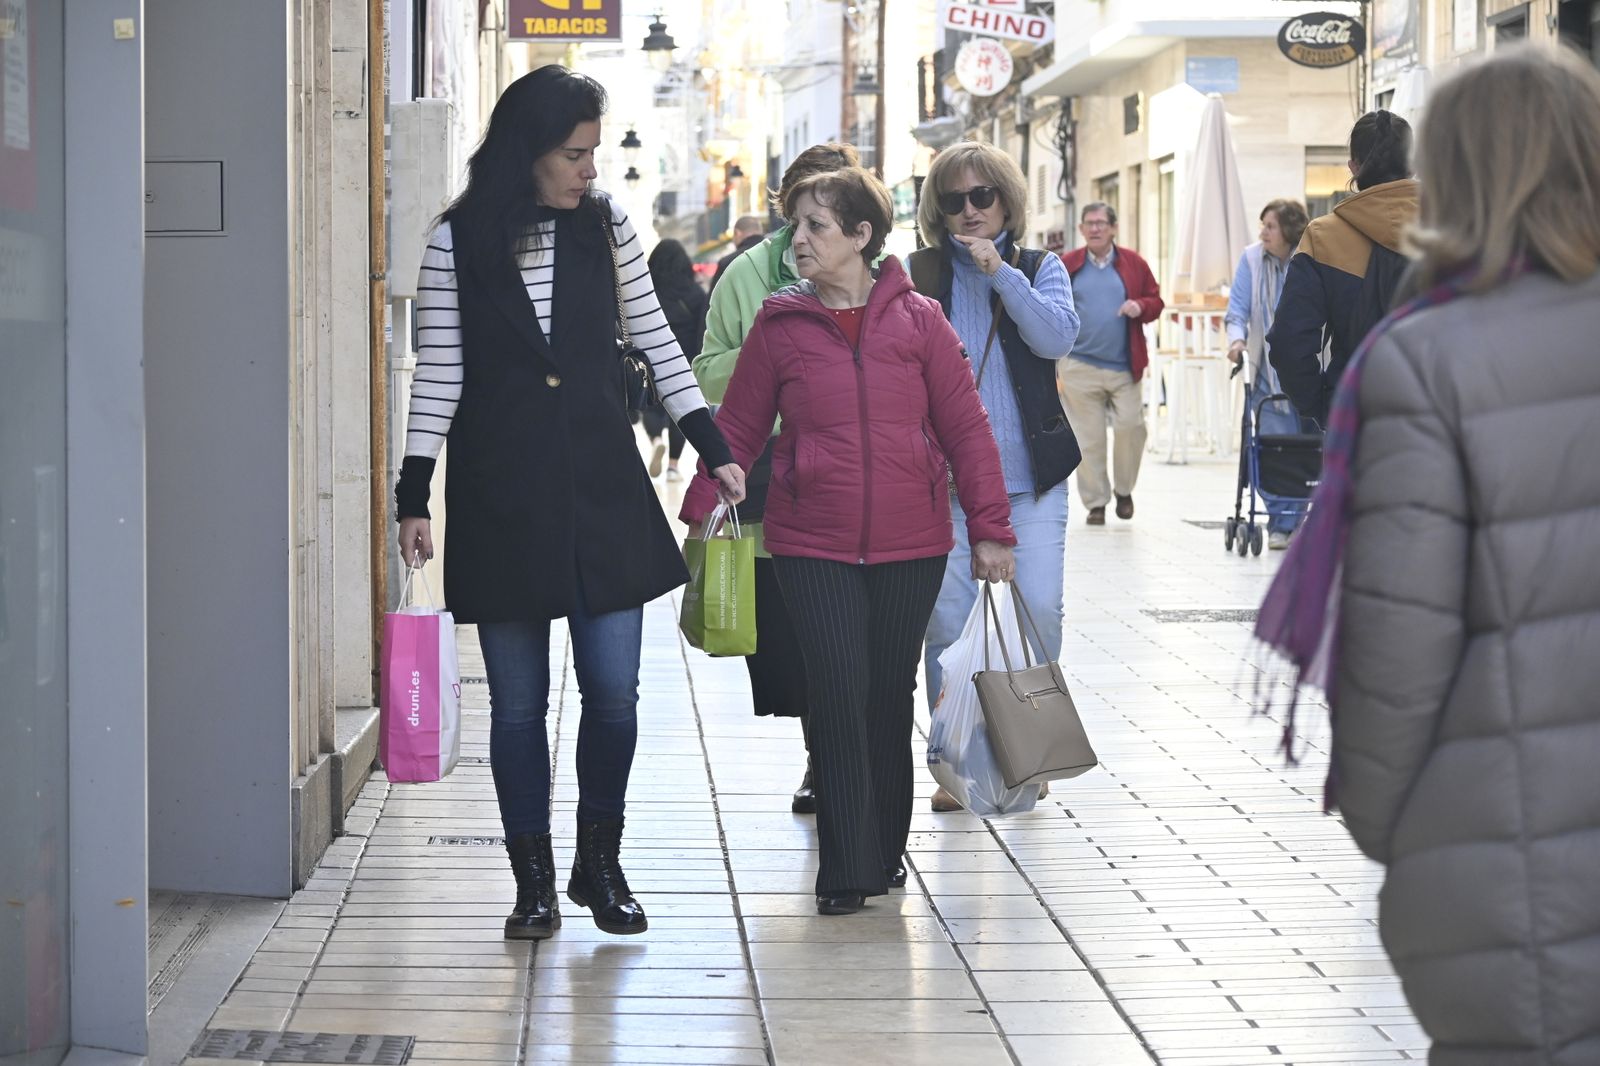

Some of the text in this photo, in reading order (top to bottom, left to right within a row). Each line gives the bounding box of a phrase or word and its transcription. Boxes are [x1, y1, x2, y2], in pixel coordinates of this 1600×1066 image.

[523, 17, 608, 35] TABACOS
[948, 6, 1046, 39] CHINO
[407, 670, 420, 727] druni.es
